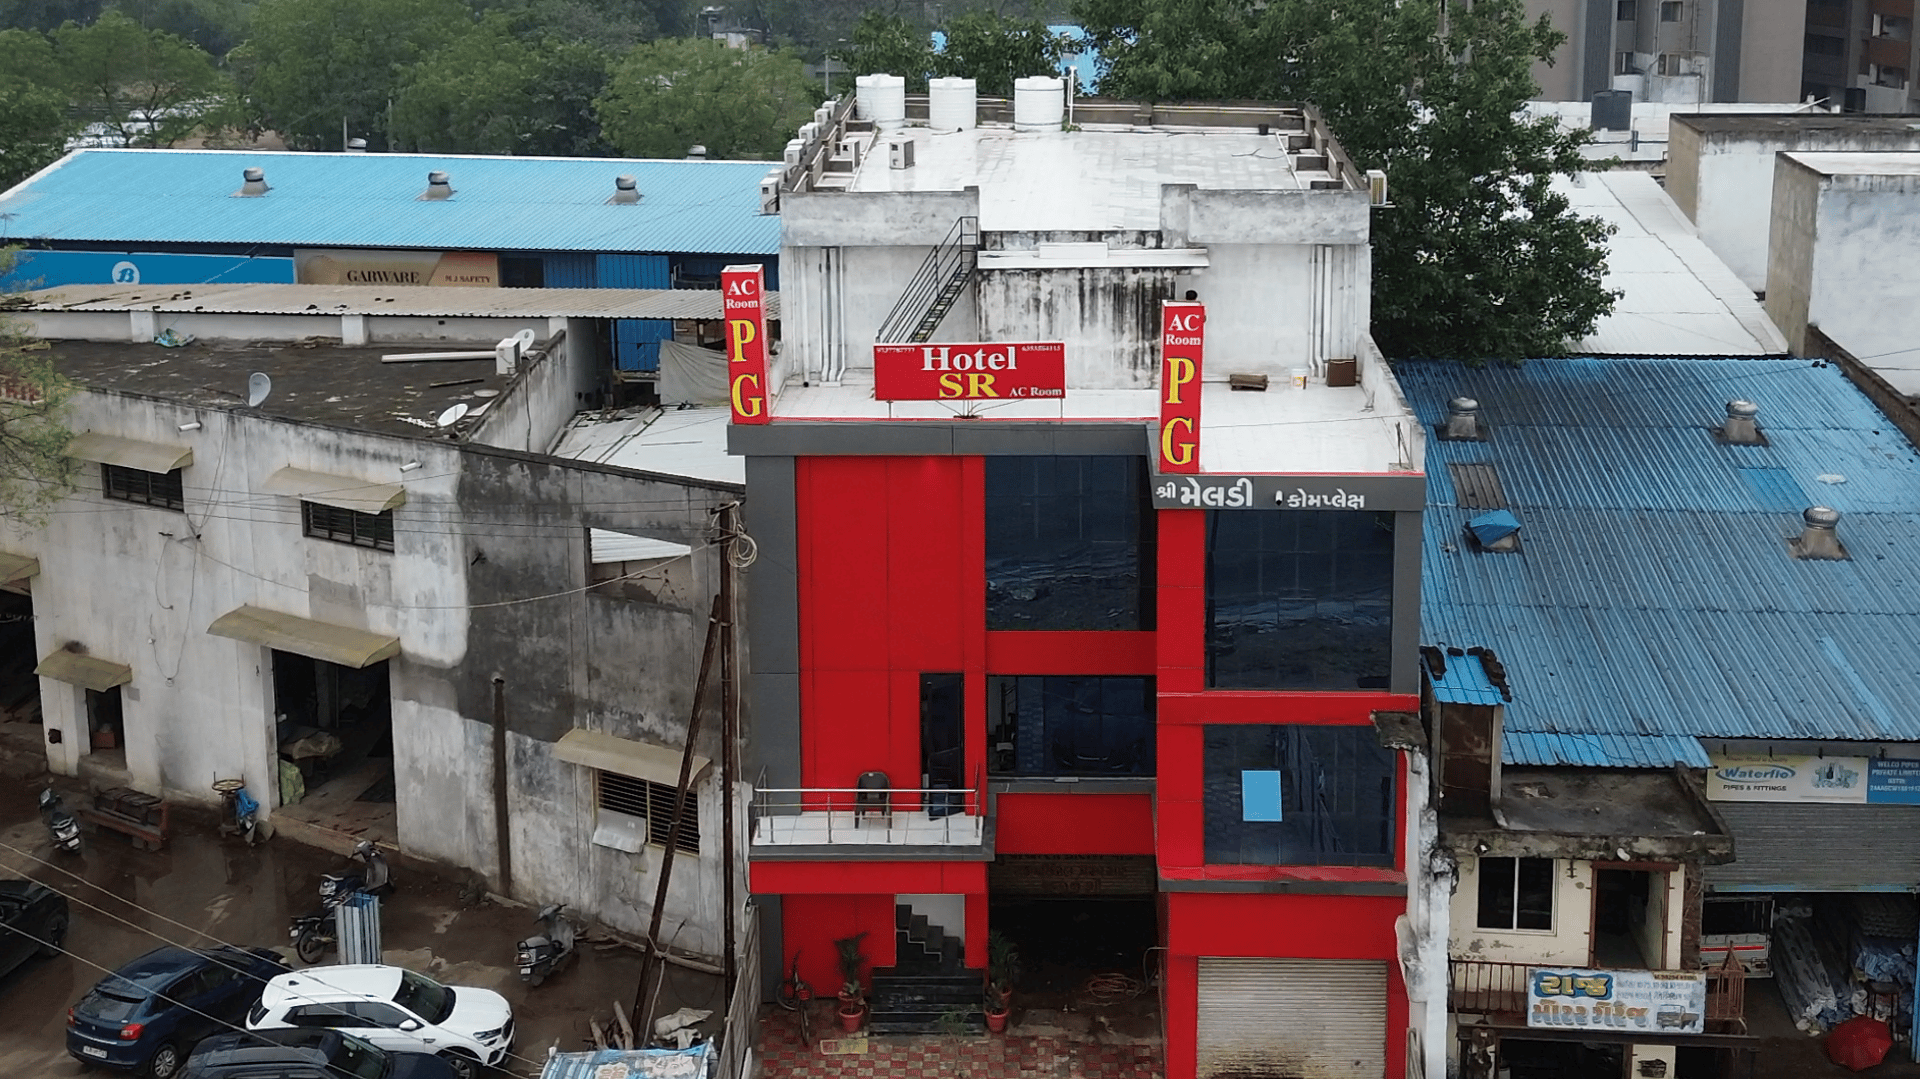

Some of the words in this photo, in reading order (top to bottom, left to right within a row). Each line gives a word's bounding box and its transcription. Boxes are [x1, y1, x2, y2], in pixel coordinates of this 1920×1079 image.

[347, 270, 420, 284] GARWARE
[459, 275, 490, 283] SAFETY
[727, 279, 755, 296] AC
[726, 298, 758, 309] Room
[1168, 313, 1200, 331] AC
[1165, 333, 1202, 346] Room
[921, 346, 1017, 371] Hotel
[939, 372, 999, 398] SR
[1009, 387, 1027, 397] AC
[1030, 387, 1062, 396] Room
[1155, 481, 1177, 499] શ્રી
[1180, 477, 1254, 507] મેલડી
[1724, 766, 1789, 779] Waterflo
